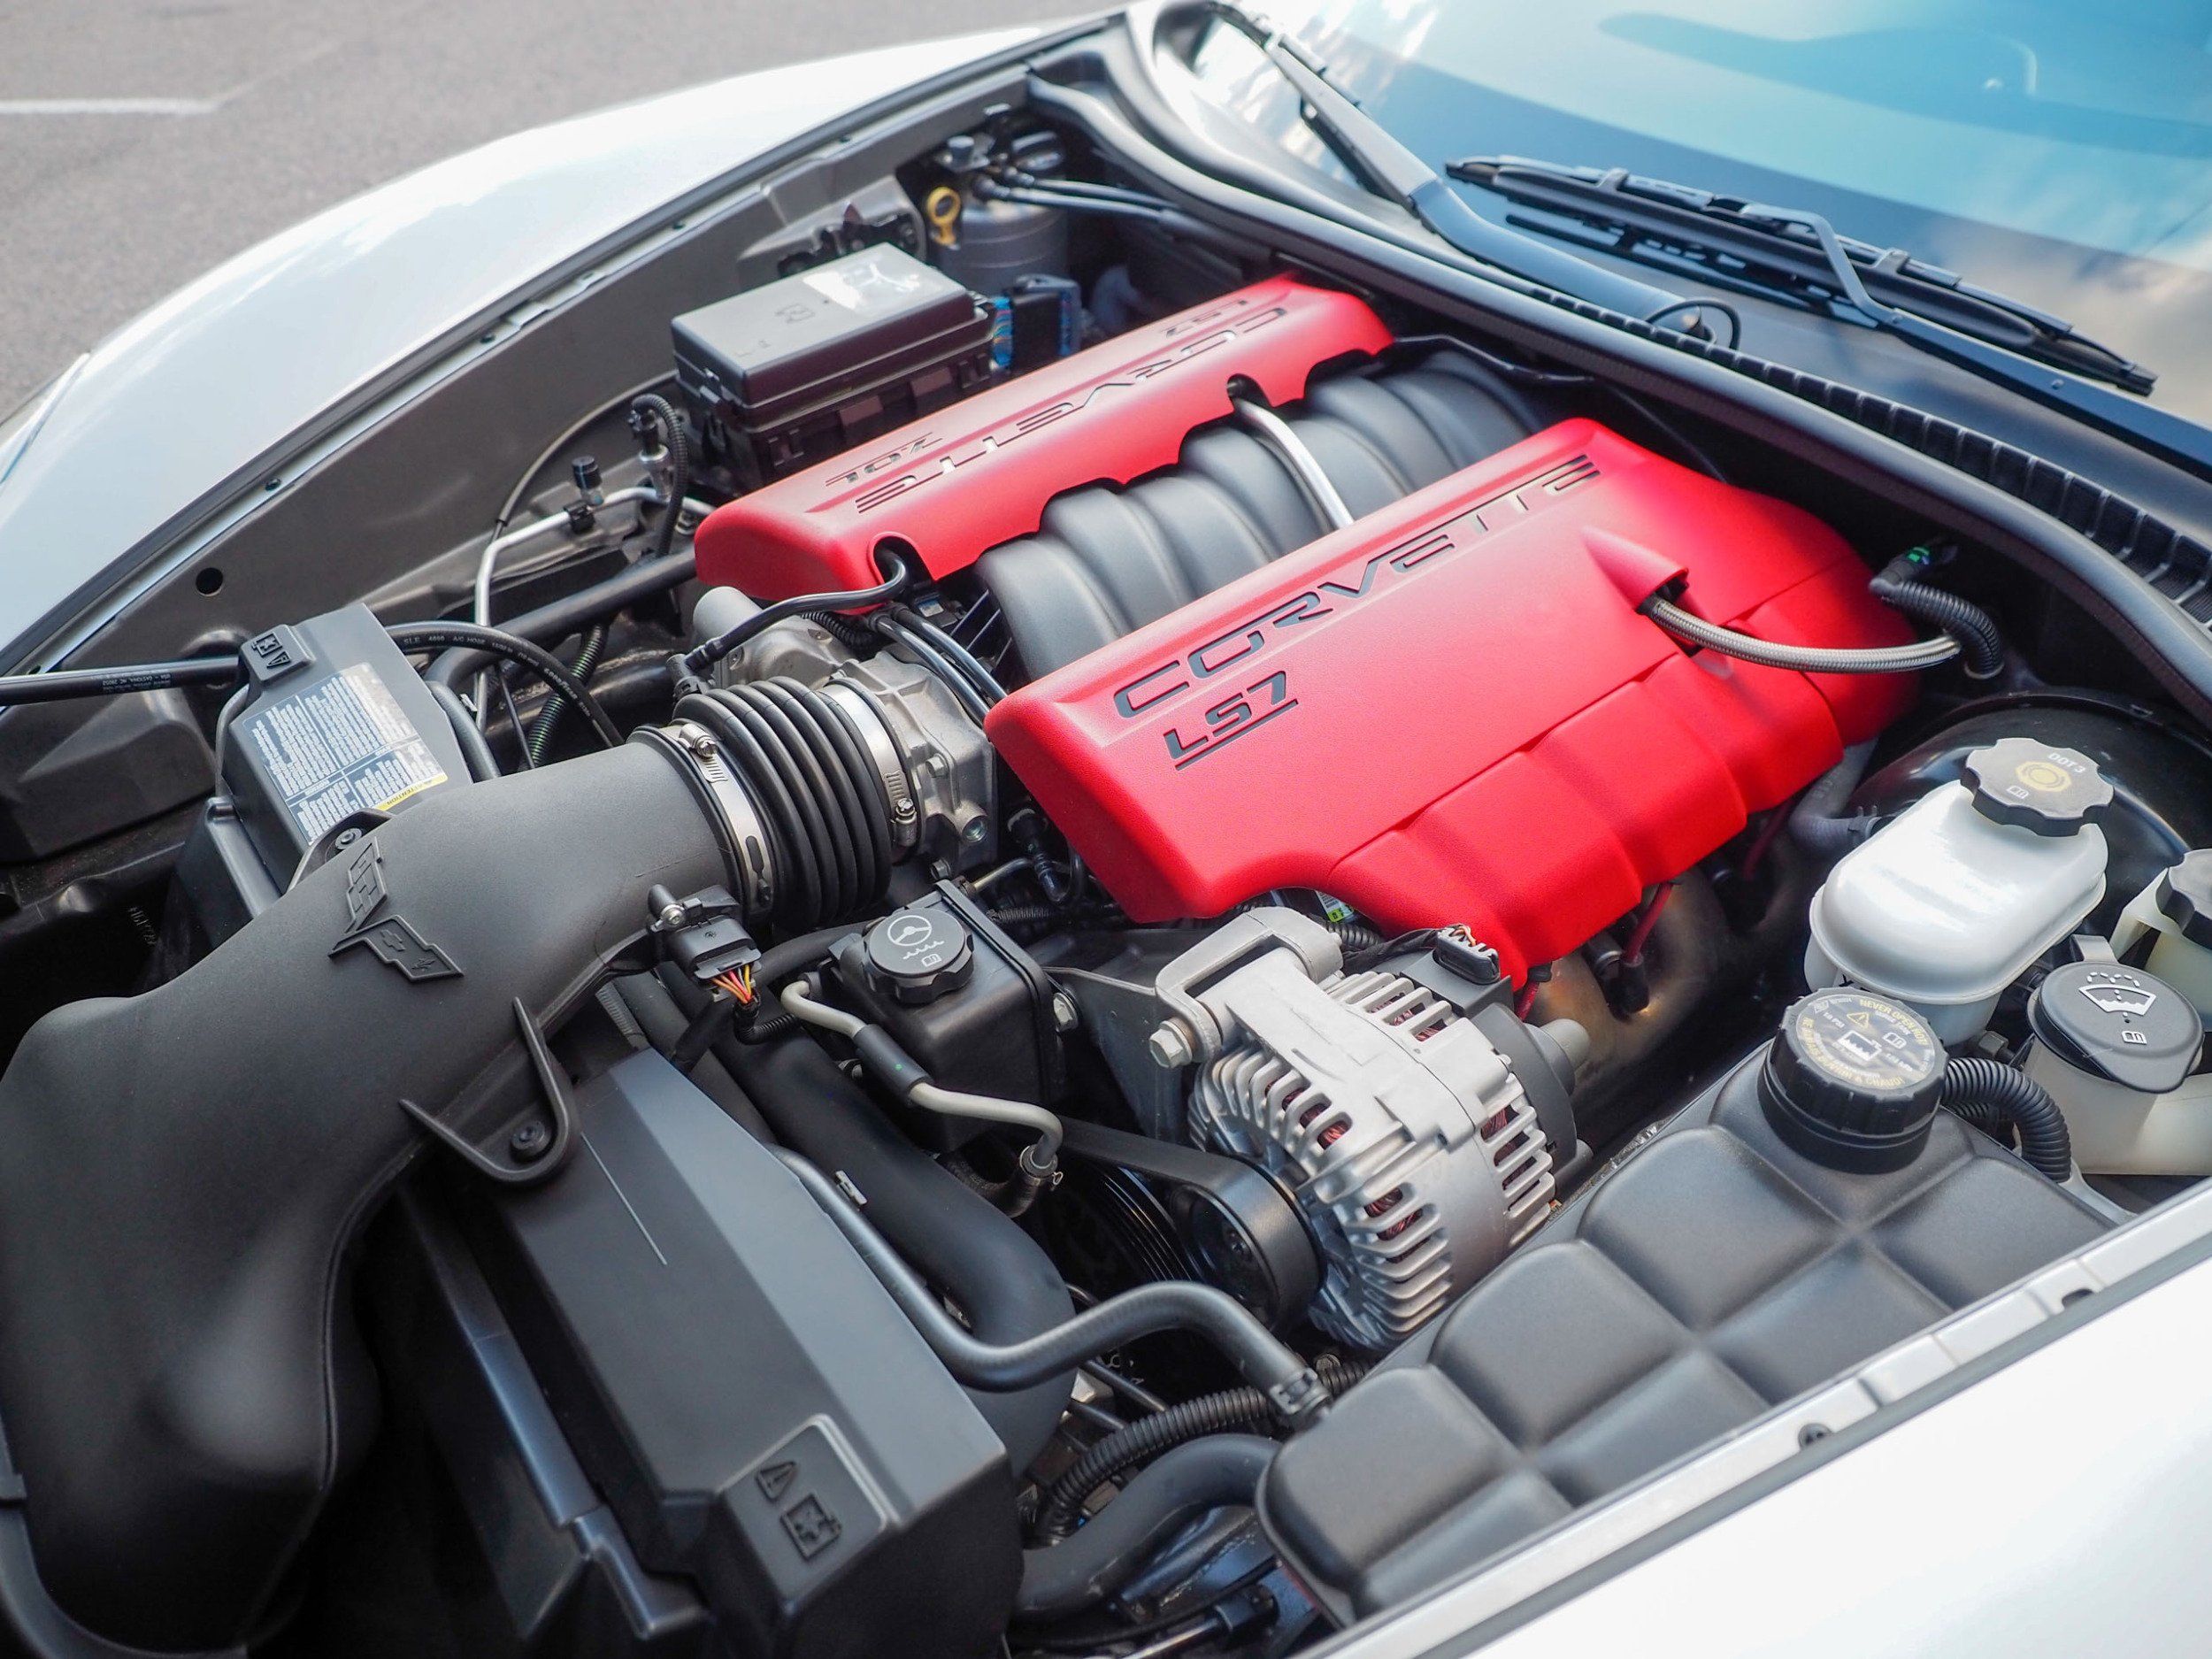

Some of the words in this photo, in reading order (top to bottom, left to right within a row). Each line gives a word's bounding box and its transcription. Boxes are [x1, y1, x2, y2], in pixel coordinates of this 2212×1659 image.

[855, 307, 1286, 514] CORVETTE
[1113, 454, 1601, 719] CORVETTE
[1163, 670, 1288, 761] LS7
[2048, 753, 2078, 768] DOT
[1859, 998, 1891, 1015] NEVER
[1892, 1011, 1915, 1030] OPEN
